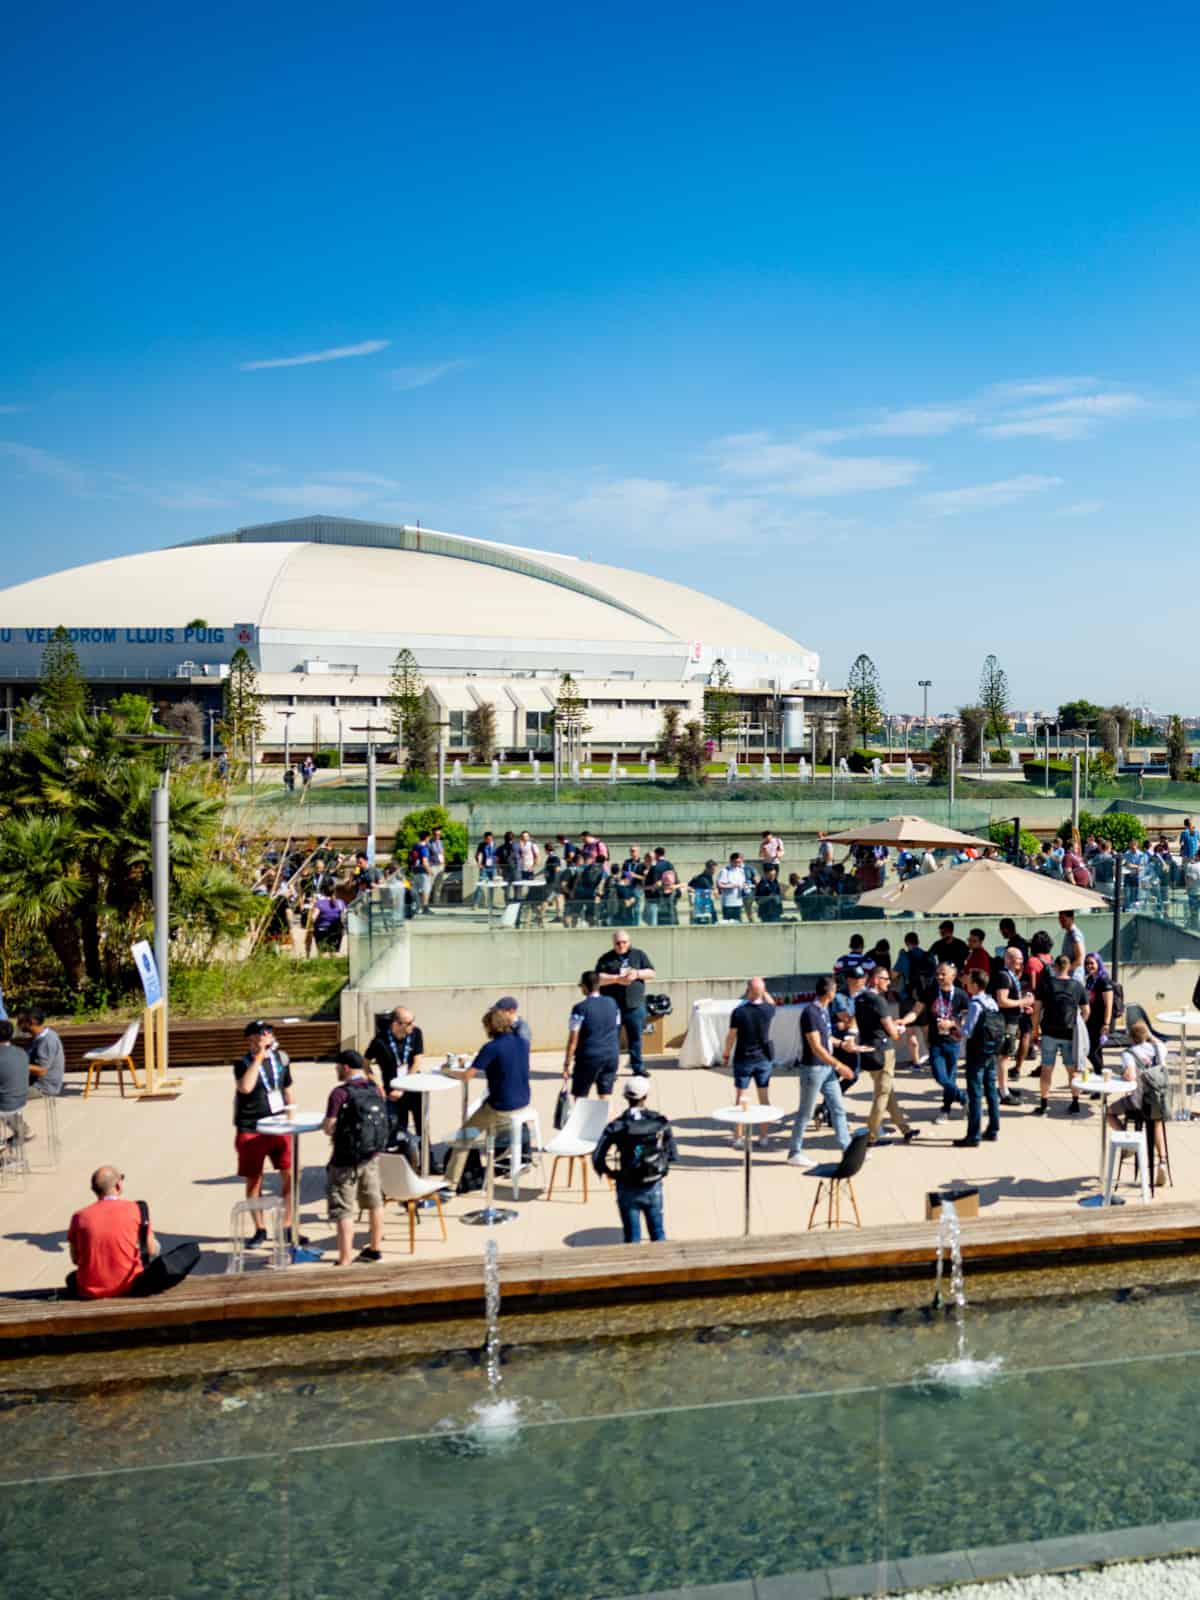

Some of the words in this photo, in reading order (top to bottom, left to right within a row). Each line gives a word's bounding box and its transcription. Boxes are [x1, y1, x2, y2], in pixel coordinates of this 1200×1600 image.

[25, 627, 117, 643] VELDROM
[126, 628, 175, 643] LLUIS
[183, 628, 225, 643] PUIG
